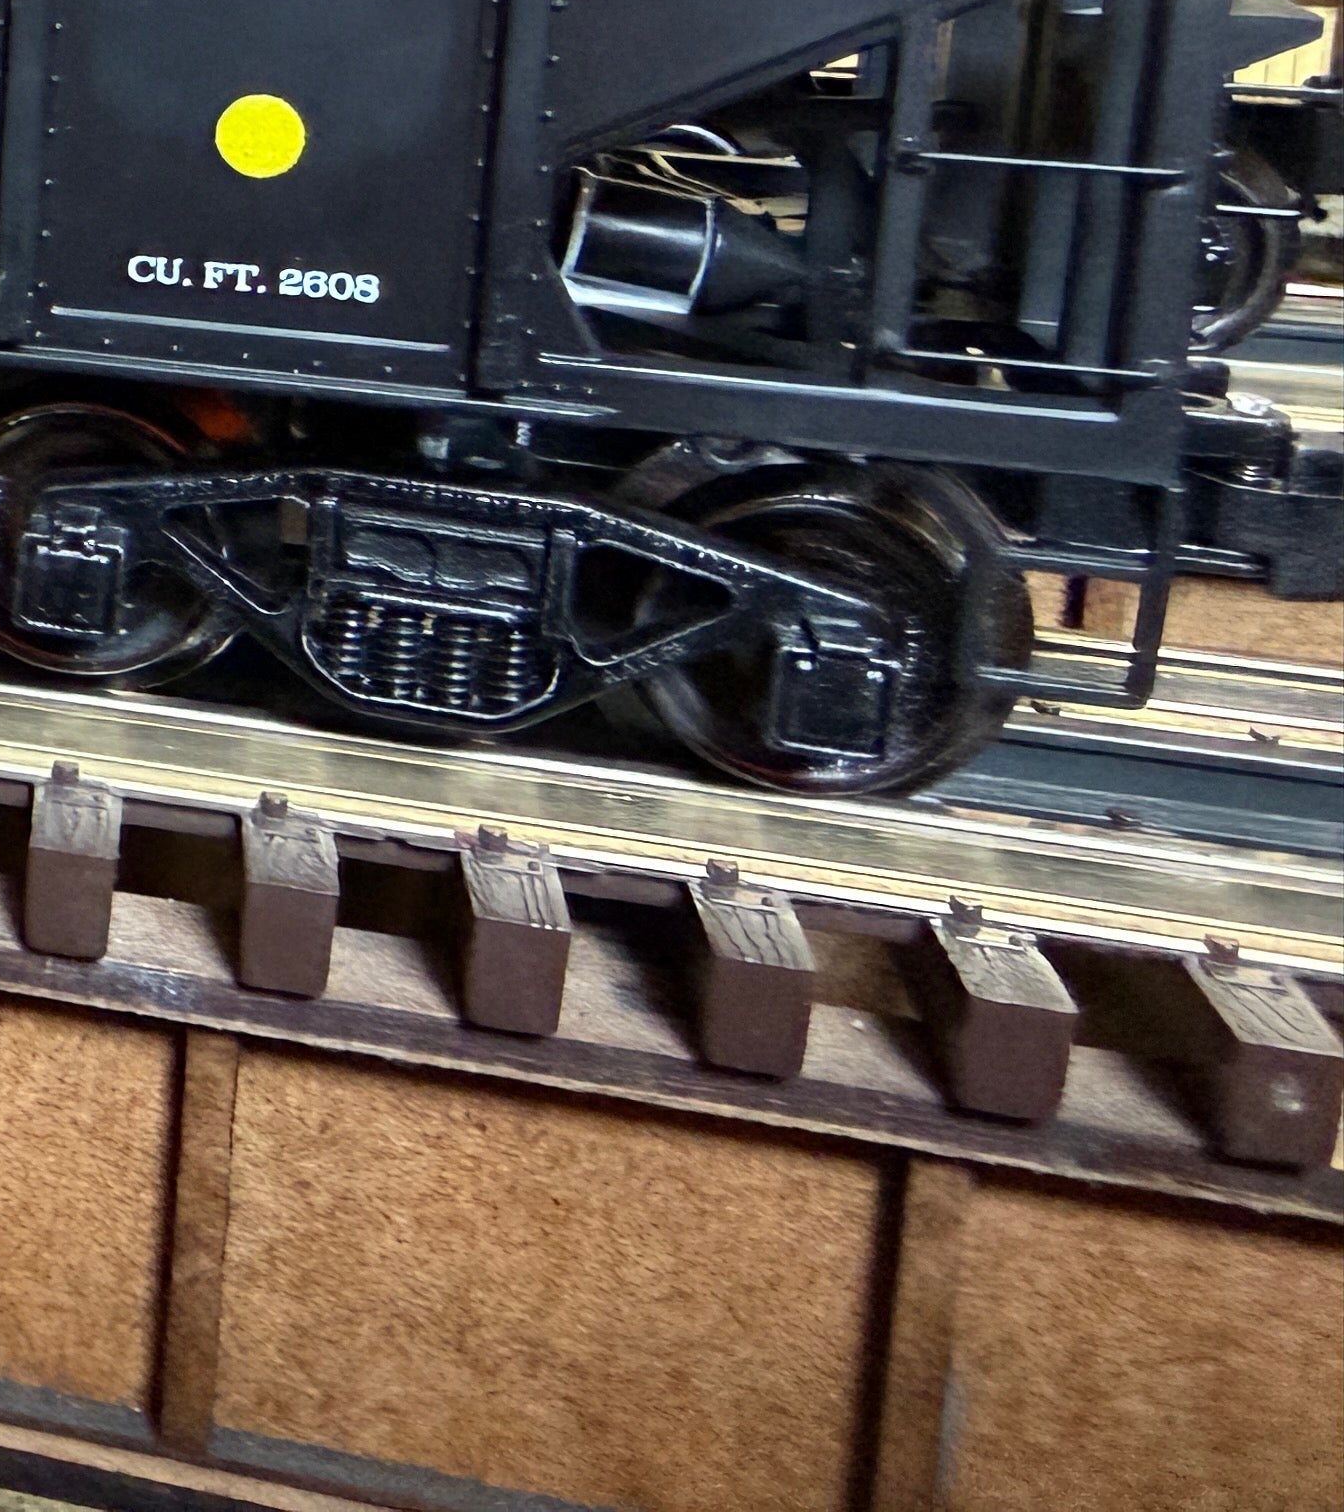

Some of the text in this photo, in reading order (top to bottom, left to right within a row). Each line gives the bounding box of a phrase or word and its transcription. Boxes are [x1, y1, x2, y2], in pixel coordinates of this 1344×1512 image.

[127, 255, 380, 304] CU. FT. 2608
